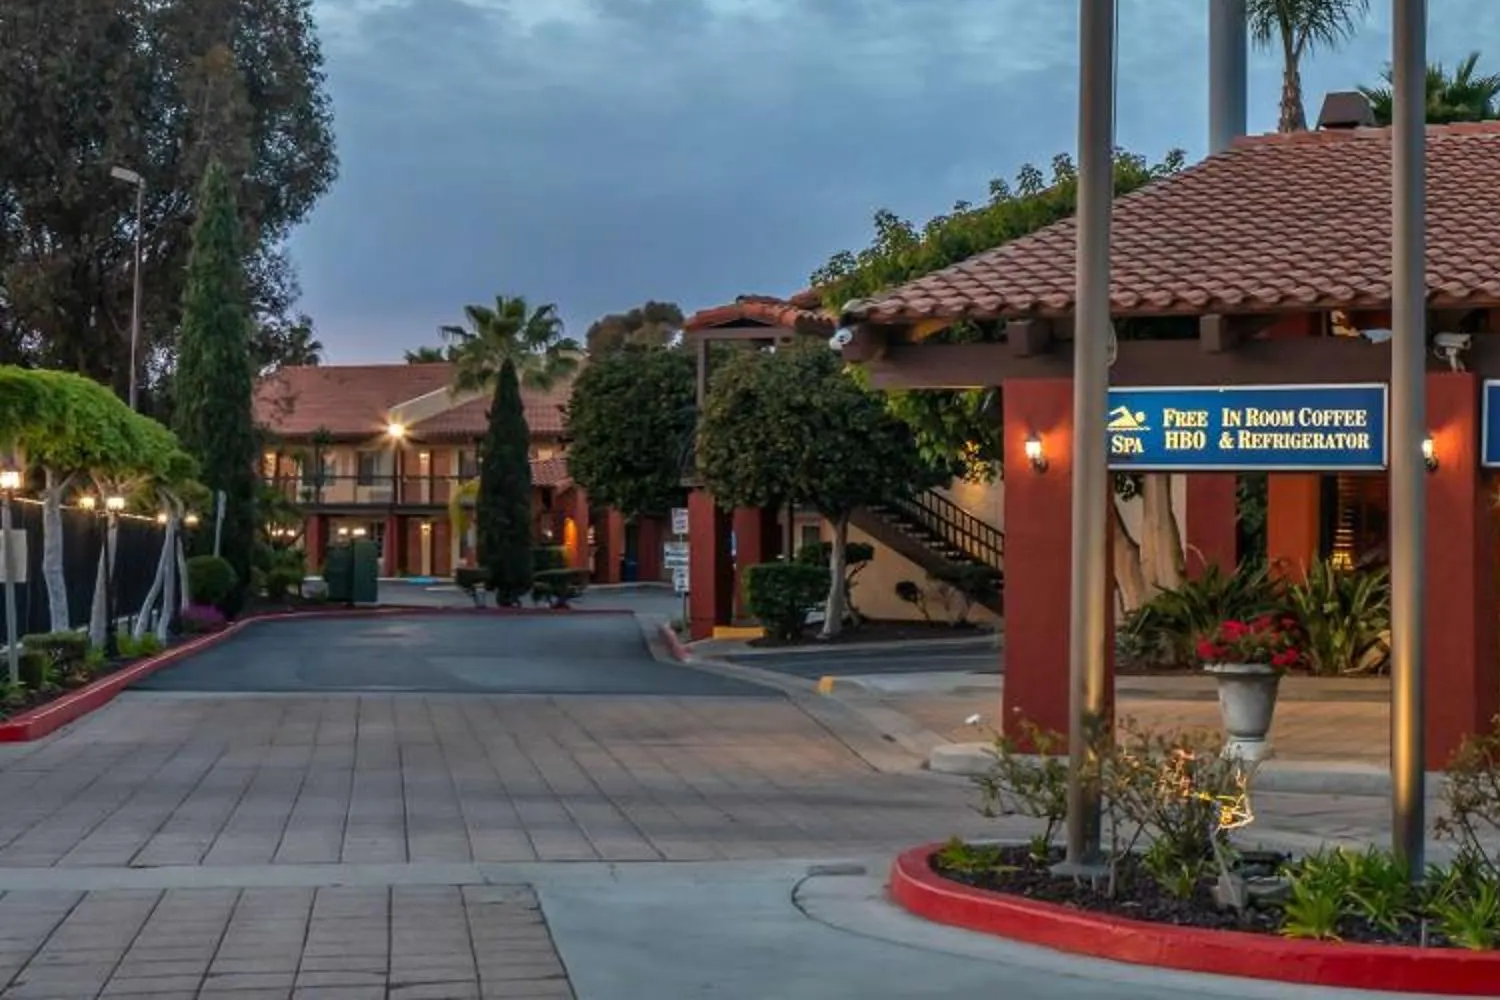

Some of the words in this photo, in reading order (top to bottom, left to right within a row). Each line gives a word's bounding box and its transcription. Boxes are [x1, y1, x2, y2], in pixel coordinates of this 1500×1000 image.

[1163, 408, 1208, 427] FREE
[1221, 408, 1241, 427] IN
[1245, 407, 1295, 427] ROOM
[1299, 407, 1367, 427] COFFEE
[1111, 435, 1144, 453] SPA
[1165, 430, 1205, 449] HBO
[1219, 431, 1234, 449] &
[1238, 430, 1369, 449] REFRIGERATOR
